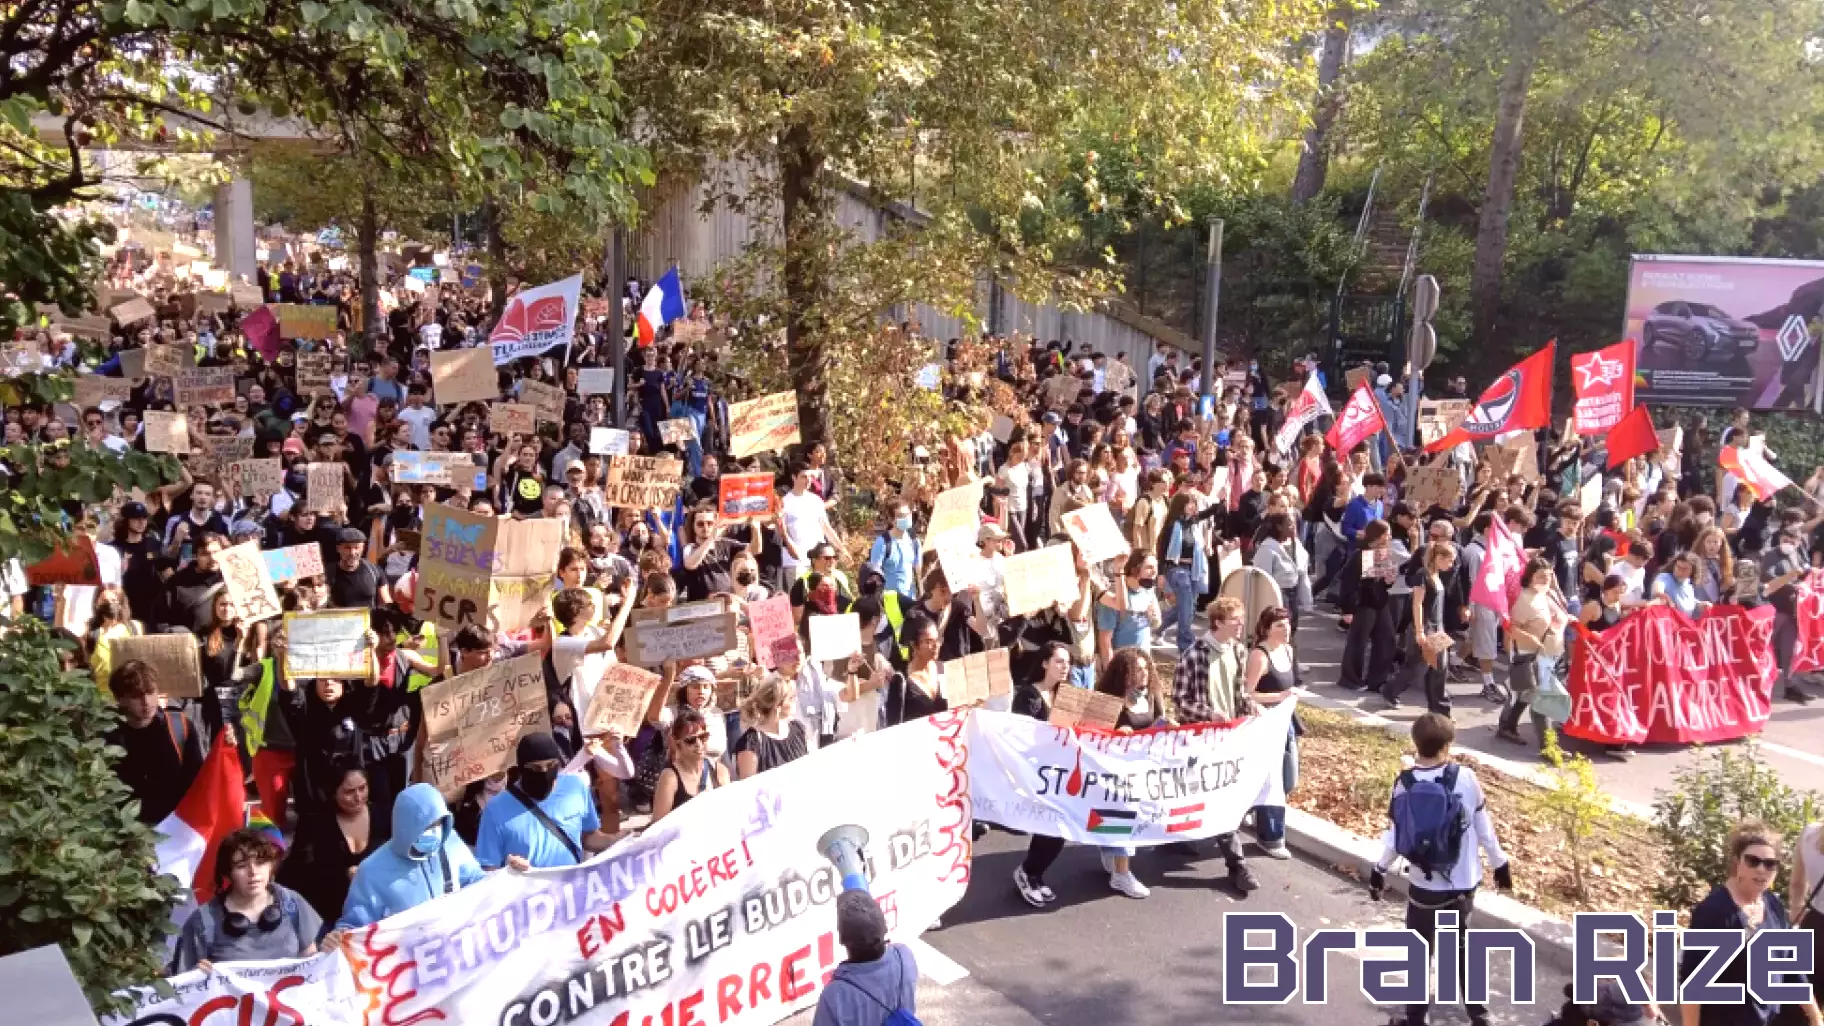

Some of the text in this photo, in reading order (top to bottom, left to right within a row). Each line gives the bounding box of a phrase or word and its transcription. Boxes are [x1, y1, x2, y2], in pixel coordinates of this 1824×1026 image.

[432, 669, 542, 719] IS THE NEW
[1036, 757, 1245, 803] STOP THE GENOCIDE
[492, 938, 676, 1026] CONTRE
[683, 911, 731, 961] LE
[743, 850, 878, 936] BUDG
[887, 819, 933, 873] DE
[576, 902, 627, 960] EN
